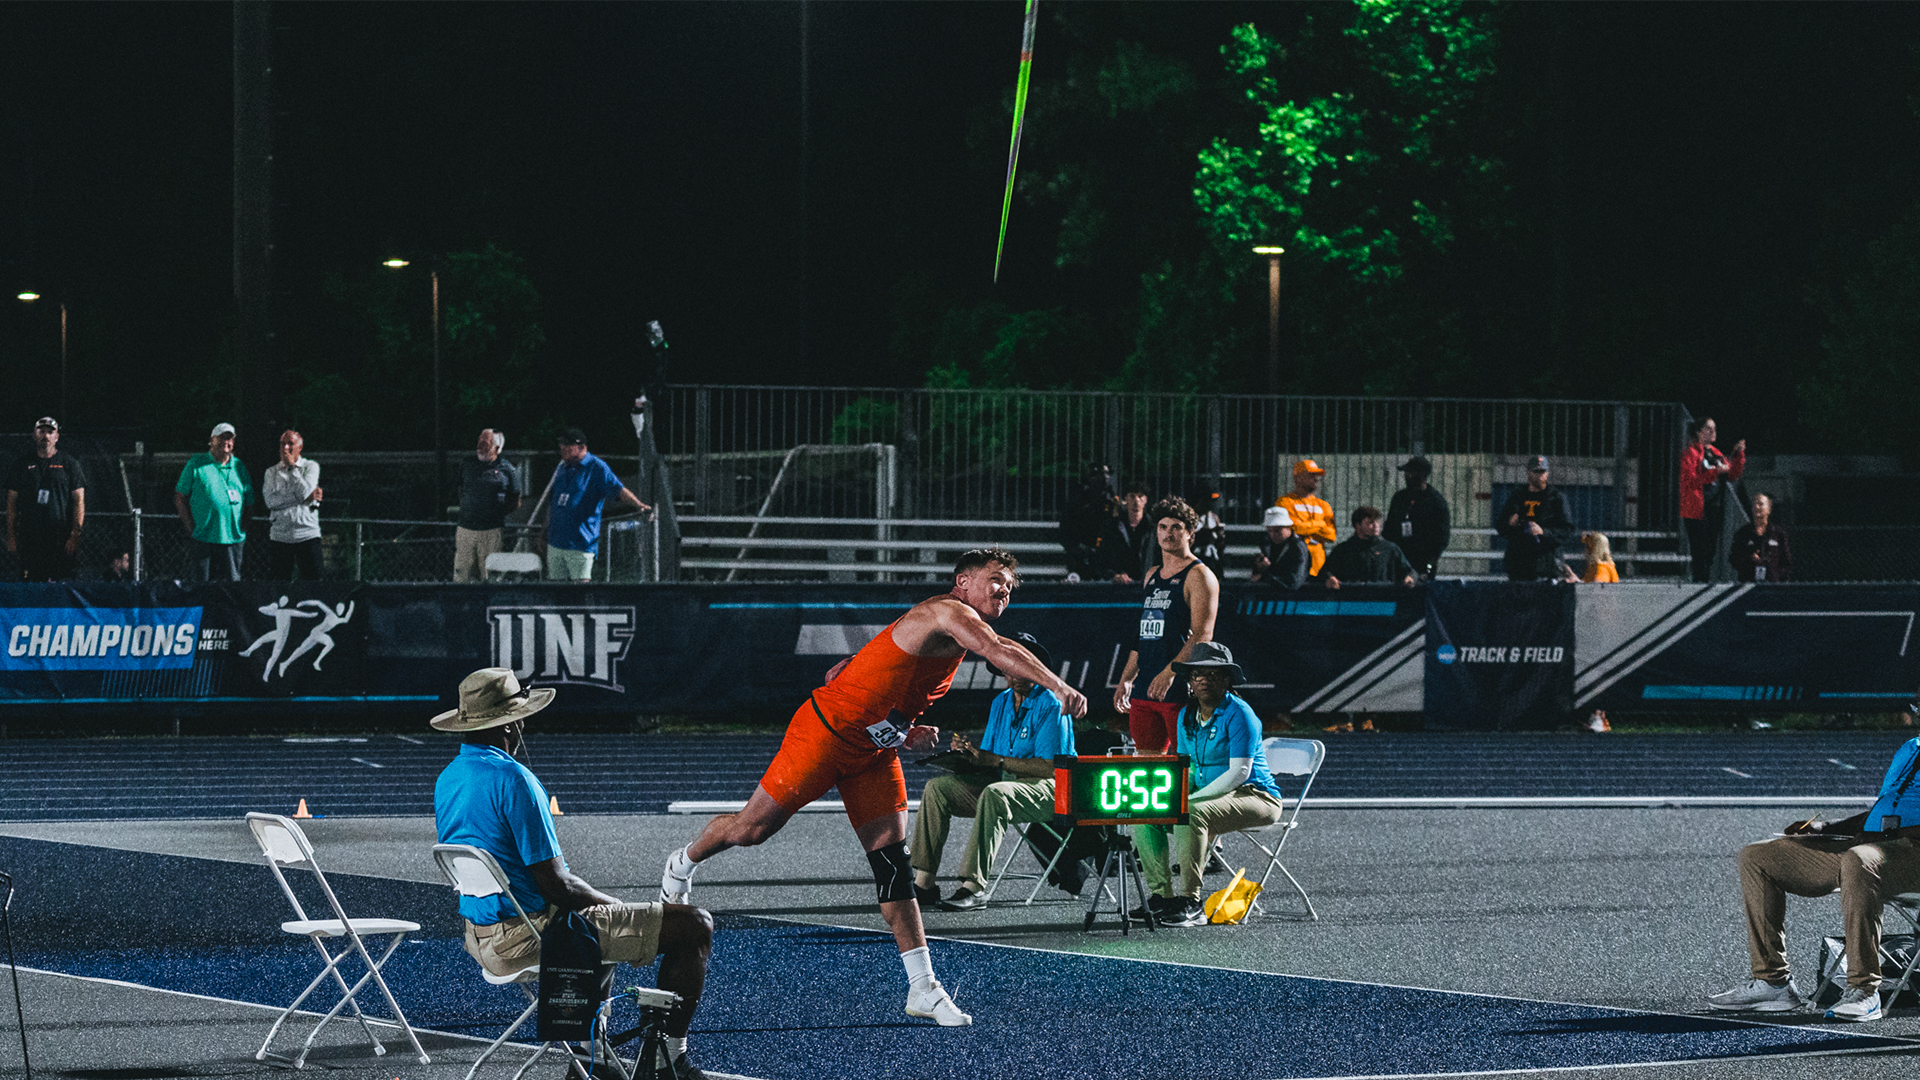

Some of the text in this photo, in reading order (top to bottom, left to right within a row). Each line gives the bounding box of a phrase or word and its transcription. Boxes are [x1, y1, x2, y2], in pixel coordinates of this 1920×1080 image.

[1524, 500, 1541, 517] T
[202, 628, 228, 639] WIN
[1141, 621, 1161, 635] 1440
[7, 623, 196, 658] CHAMPIONS
[198, 640, 229, 651] HERE
[494, 613, 628, 681] UNF
[1460, 646, 1507, 663] TRACK
[1509, 646, 1521, 663] &
[1524, 646, 1564, 663] FIELD
[1101, 769, 1172, 811] 0:52
